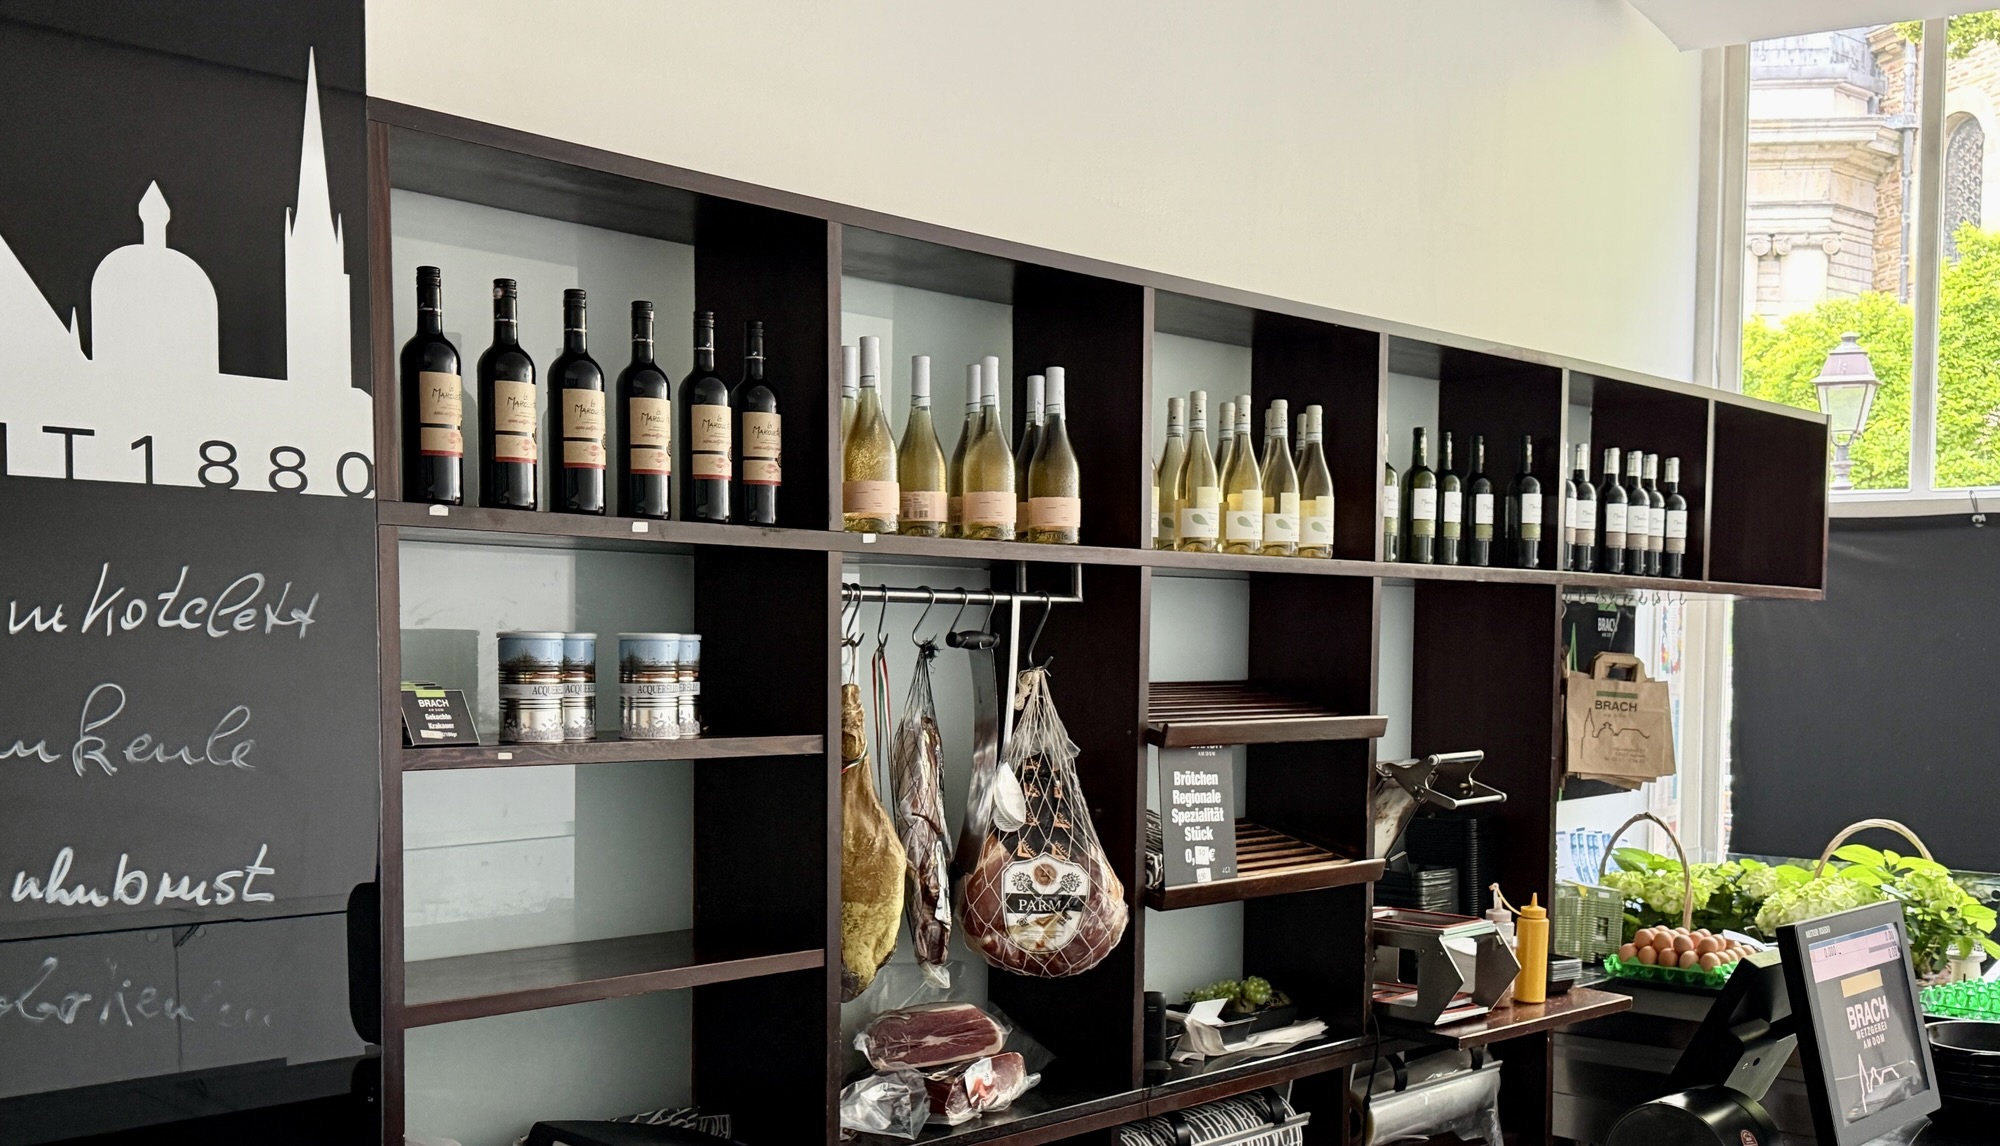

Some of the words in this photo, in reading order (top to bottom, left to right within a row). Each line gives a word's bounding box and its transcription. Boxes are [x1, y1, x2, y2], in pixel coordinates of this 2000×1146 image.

[417, 699, 450, 708] BRACH
[1594, 700, 1638, 712] BRACH
[1173, 771, 1219, 786] Brötchen
[1172, 789, 1222, 807] Regionale
[1171, 807, 1225, 826] Spezialität
[1184, 826, 1214, 842] Stück
[1846, 995, 1890, 1031] BRACH
[1855, 1021, 1888, 1040] METZGEREI
[1863, 1038, 1872, 1049] AM
[1872, 1033, 1886, 1046] DOM
